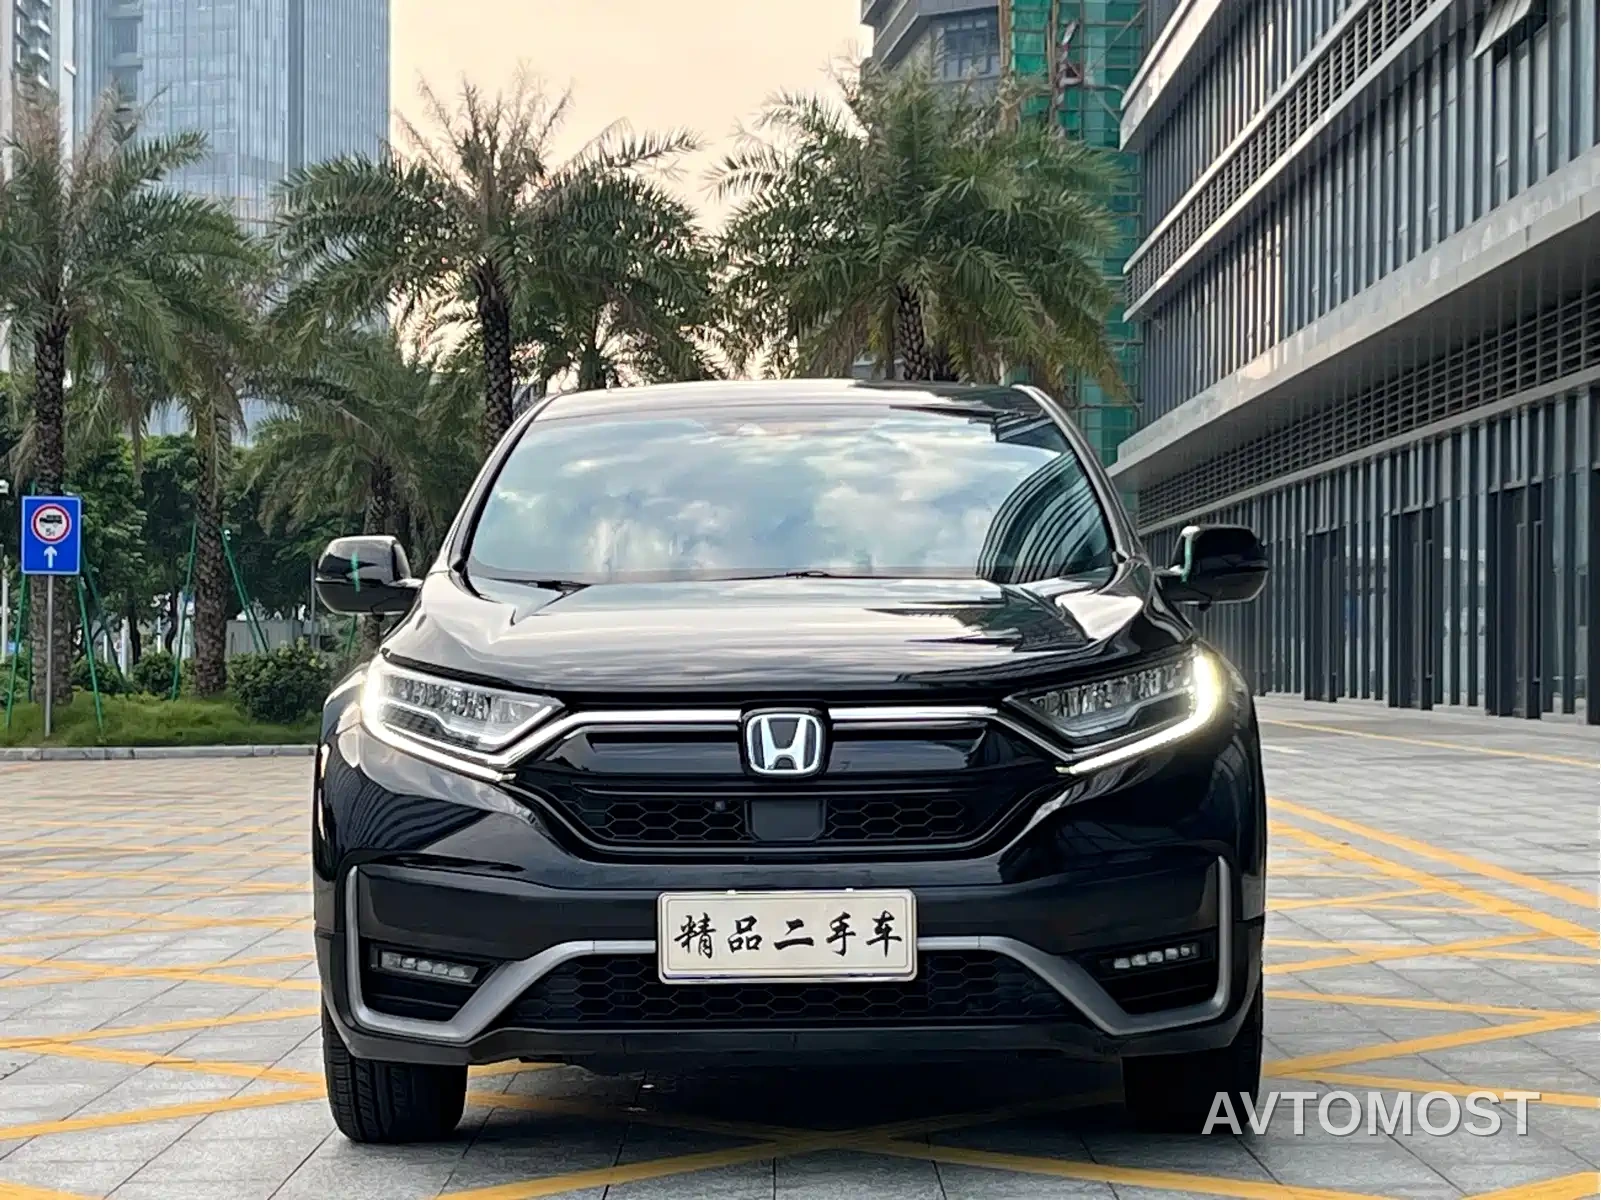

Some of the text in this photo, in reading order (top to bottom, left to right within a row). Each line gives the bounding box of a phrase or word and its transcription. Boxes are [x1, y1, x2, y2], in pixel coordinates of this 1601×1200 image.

[674, 911, 902, 960] 精品二手车
